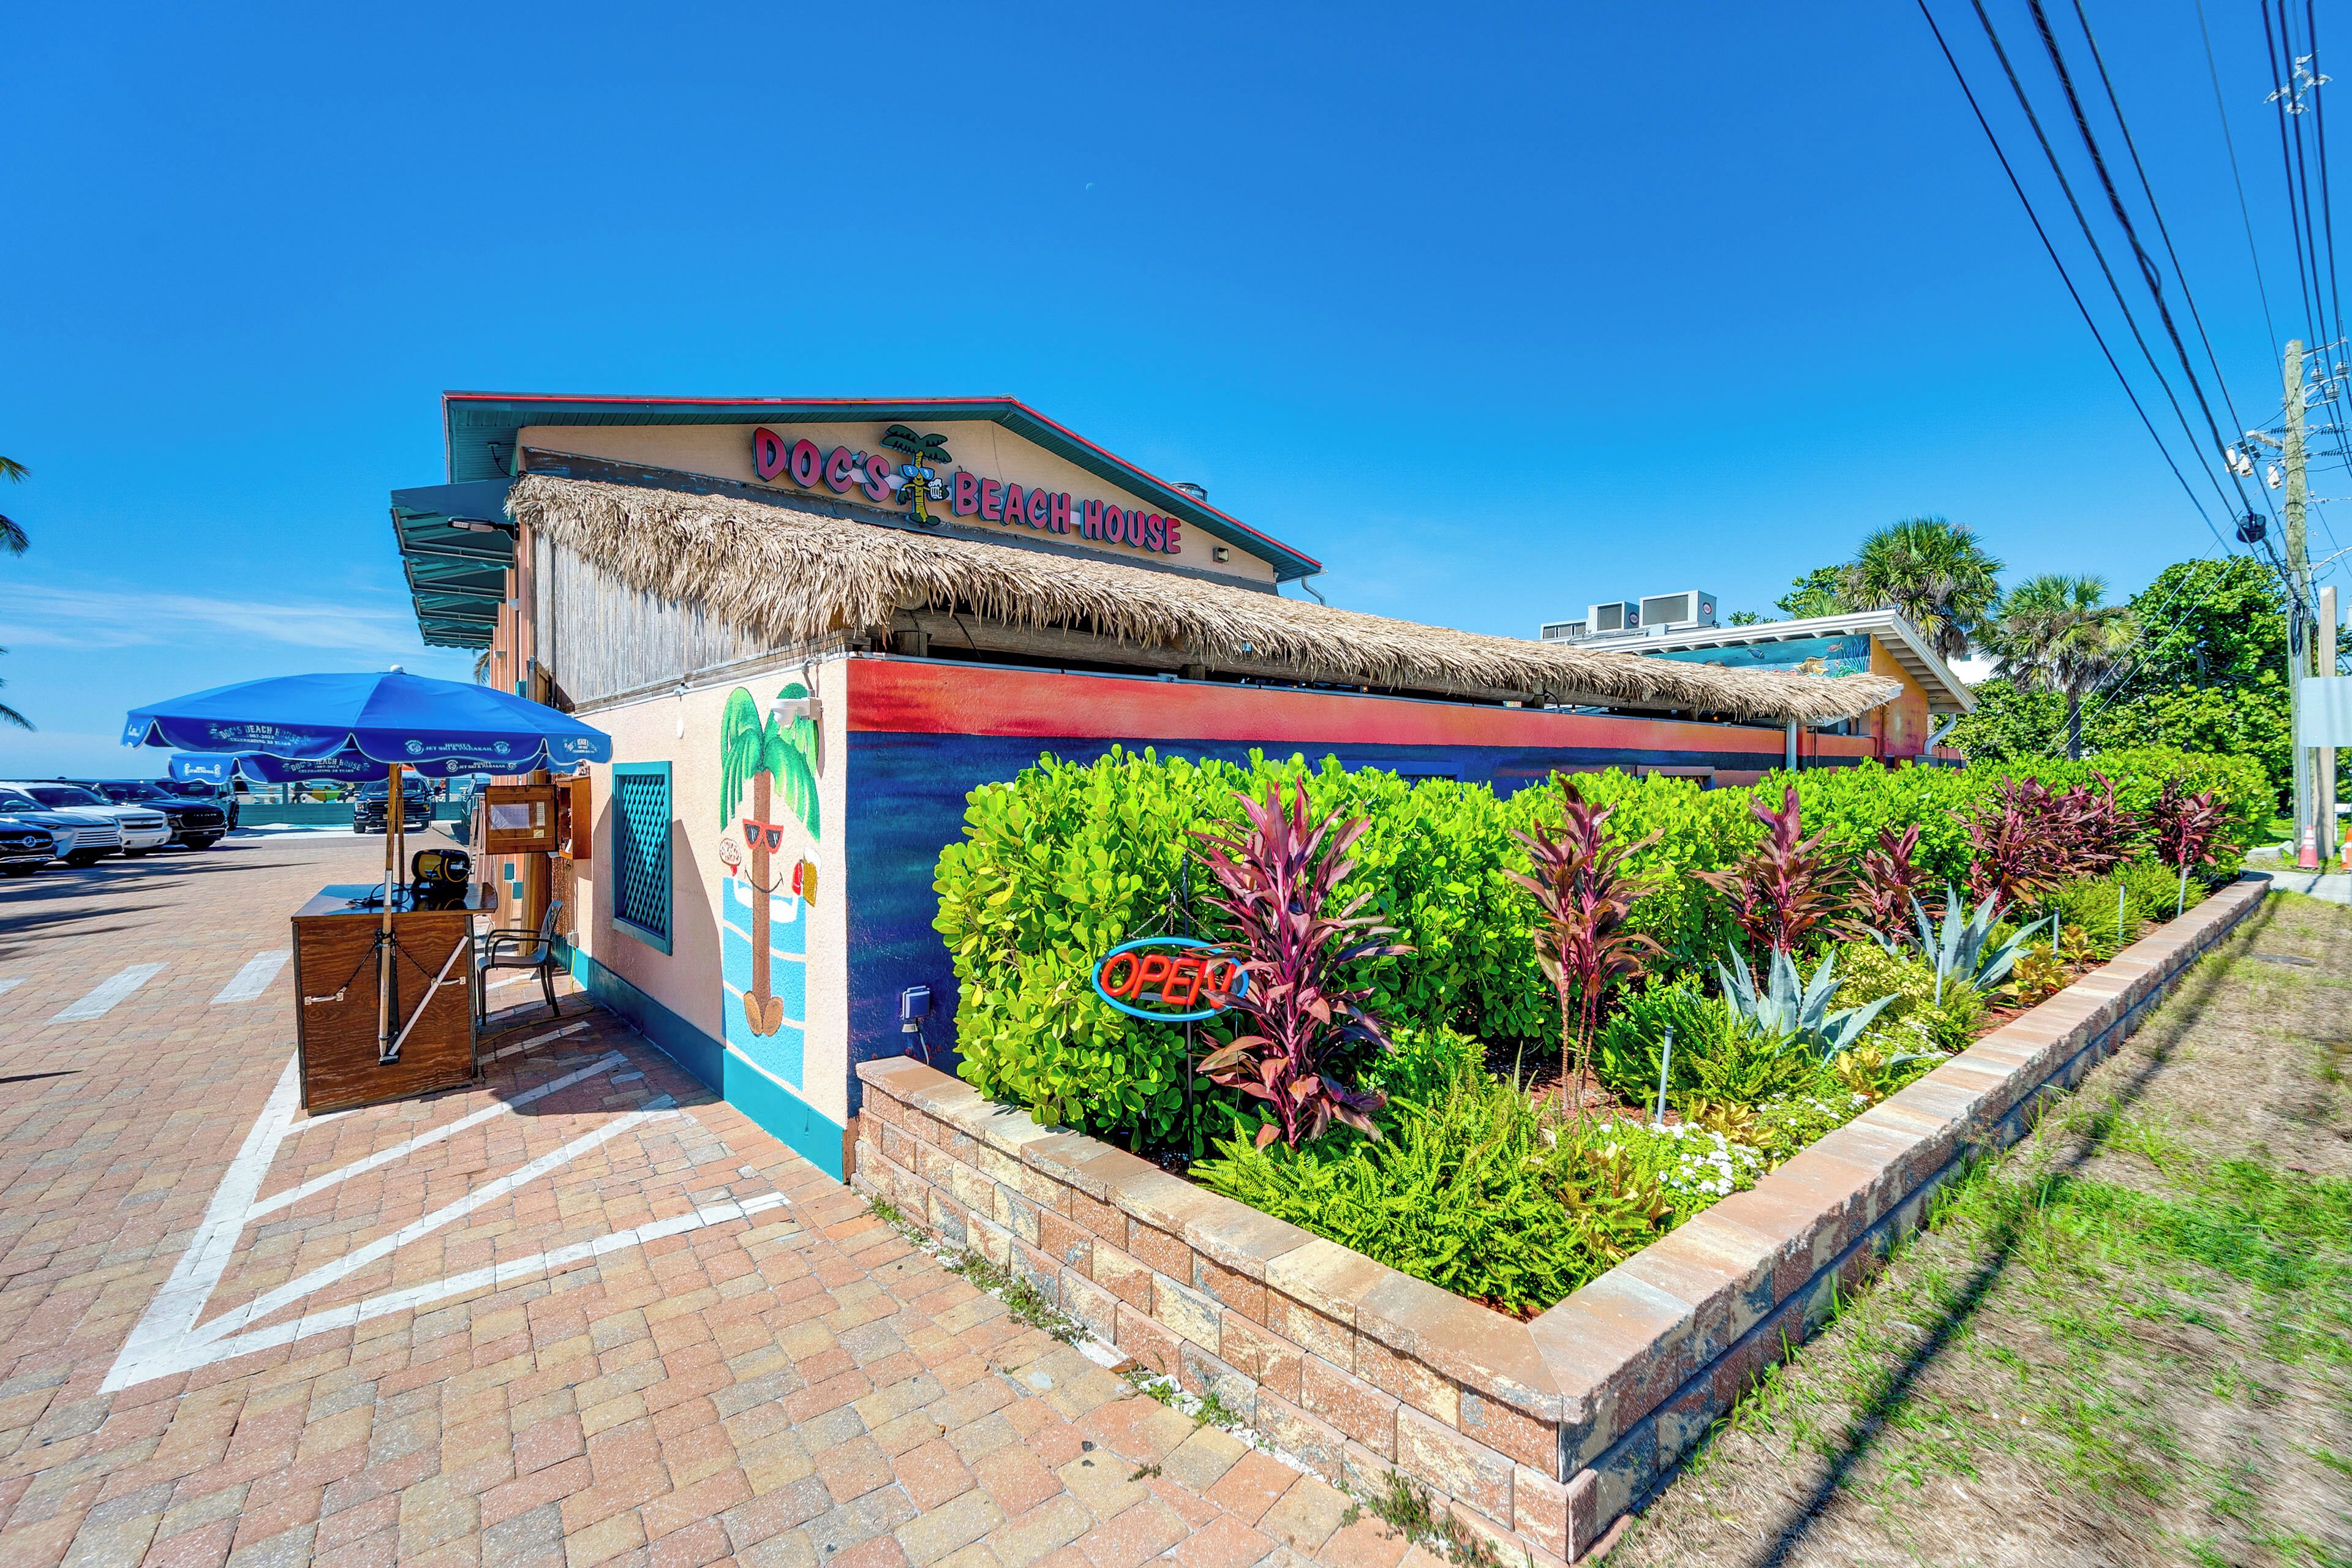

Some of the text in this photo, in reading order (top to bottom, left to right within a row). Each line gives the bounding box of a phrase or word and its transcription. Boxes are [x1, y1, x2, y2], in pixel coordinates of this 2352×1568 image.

[753, 426, 1181, 554] DOC'S BEACH HOUSE
[219, 726, 243, 739] DOC'S
[290, 761, 312, 772] DOC'S
[1101, 951, 1236, 1009] OPEN
